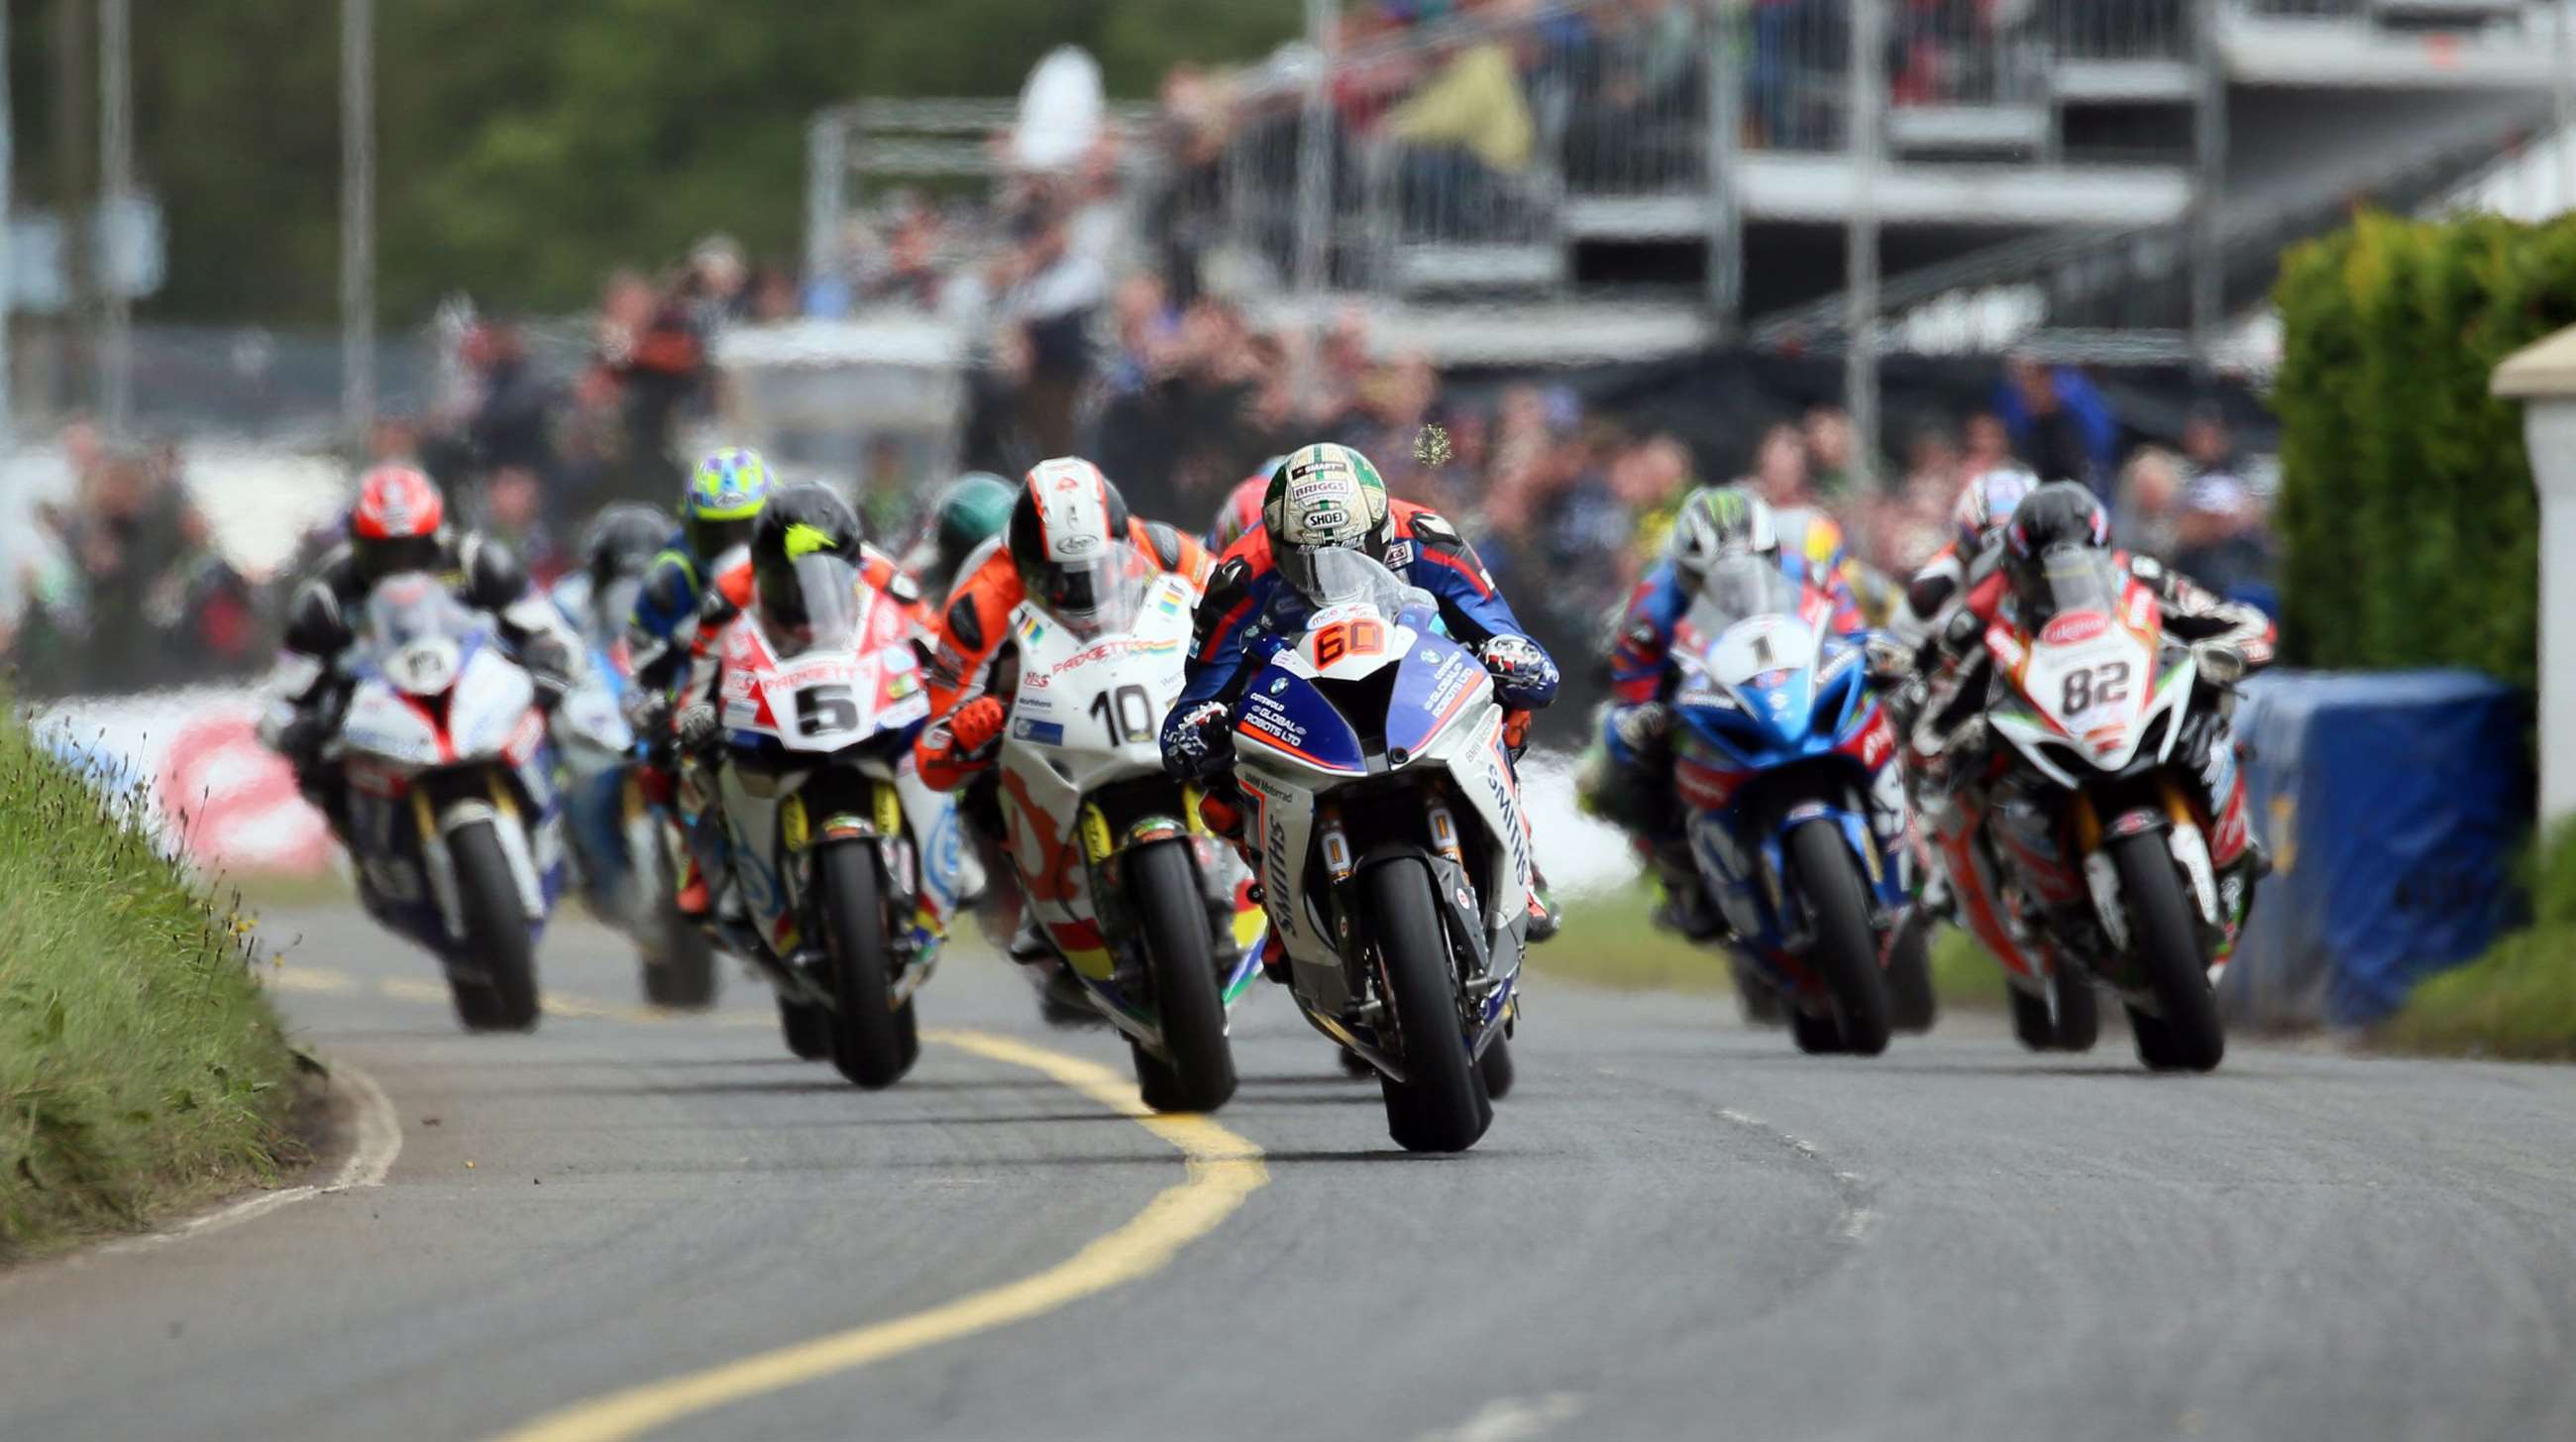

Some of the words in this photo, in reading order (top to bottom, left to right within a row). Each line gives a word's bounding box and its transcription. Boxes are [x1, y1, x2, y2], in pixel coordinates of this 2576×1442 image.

[1295, 482, 1344, 498] BRIGGS
[1310, 512, 1342, 526] SHOEI
[1312, 609, 1339, 627] mce
[1315, 618, 1383, 670] 60
[1753, 635, 1773, 663] 1
[1249, 692, 1285, 712] COTSWOLD
[2062, 661, 2130, 716] 82
[796, 684, 859, 736] 5
[1089, 684, 1155, 747] 10
[1259, 707, 1297, 732] GLOBAL
[1244, 712, 1282, 737] ROBOTS
[1281, 731, 1301, 746] LTD
[1488, 763, 1527, 886] SMITHS
[1267, 814, 1298, 938] SMITHS
